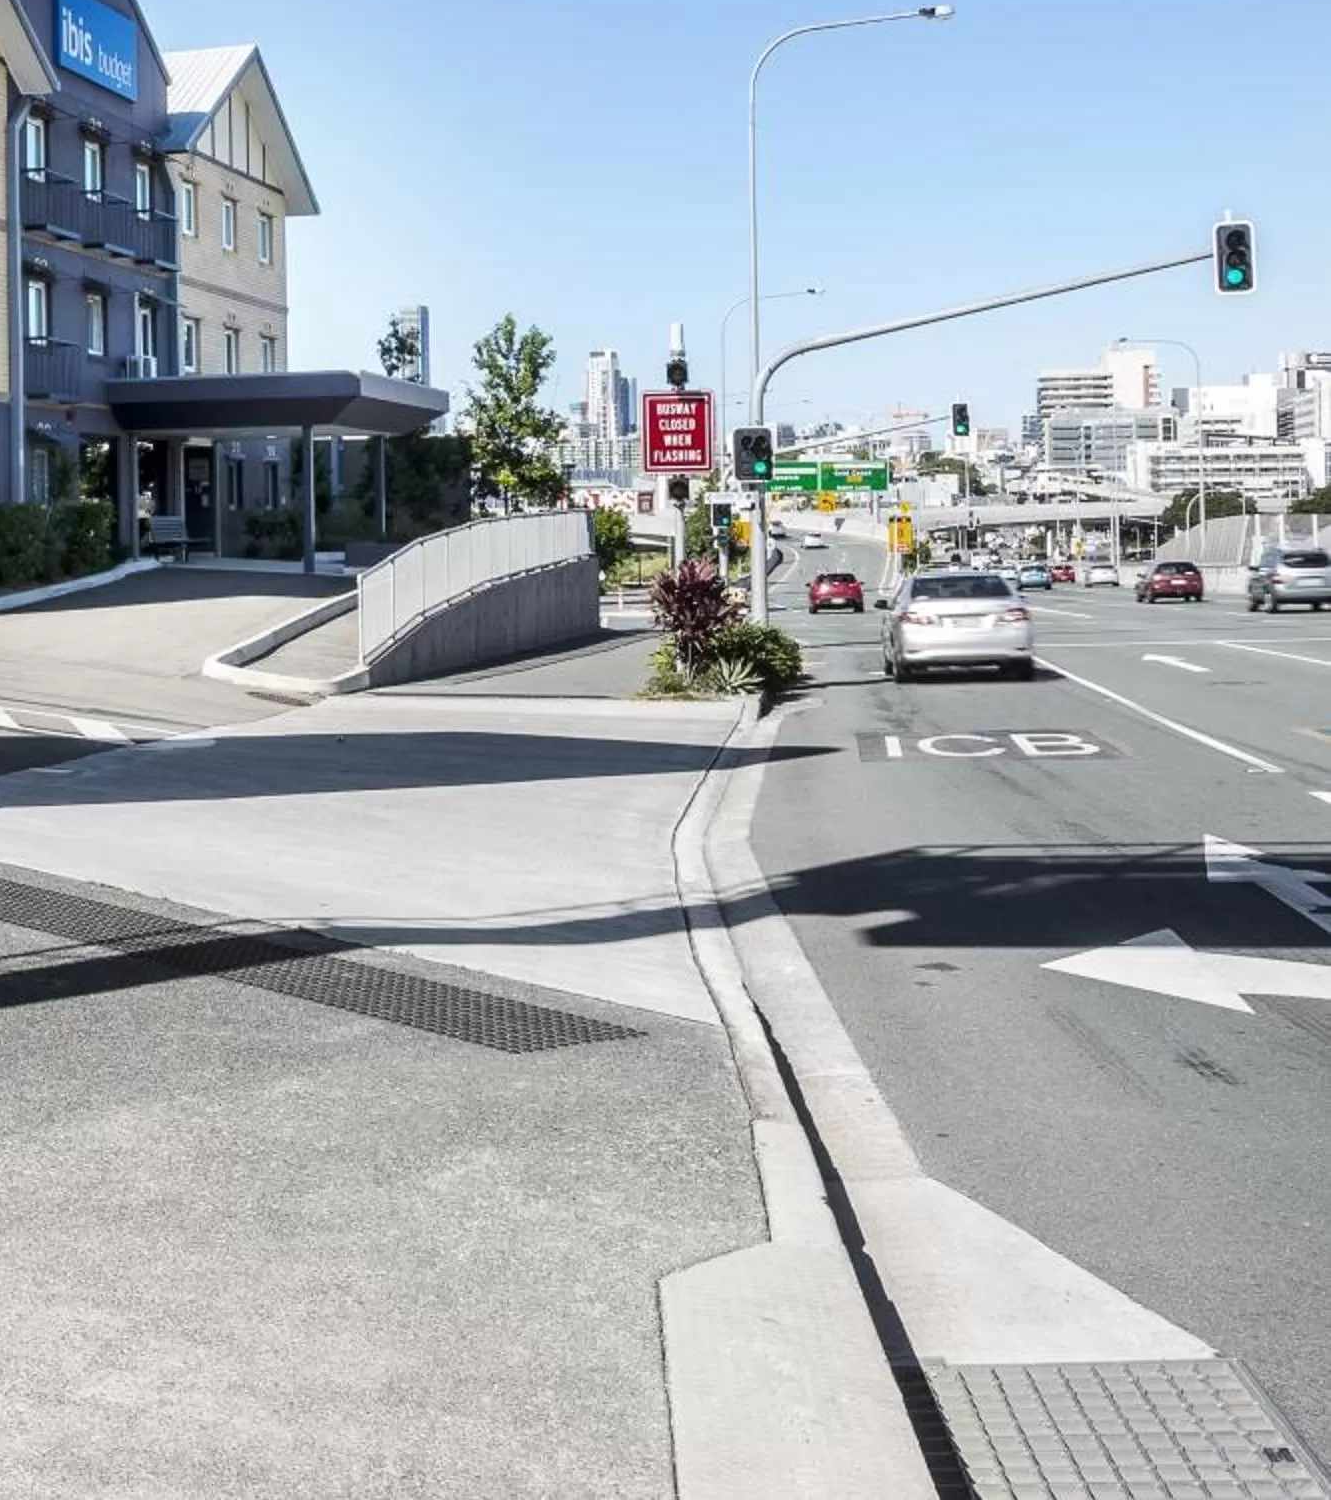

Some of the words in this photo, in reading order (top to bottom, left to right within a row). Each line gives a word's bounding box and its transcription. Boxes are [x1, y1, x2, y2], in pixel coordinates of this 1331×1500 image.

[62, 5, 92, 65] ibis
[98, 42, 134, 88] budget
[656, 403, 698, 415] BUSWAY
[658, 418, 696, 431] CLOSED
[662, 433, 692, 447] WHEN
[653, 449, 702, 463] FLASHING
[884, 733, 1100, 758] ICB
